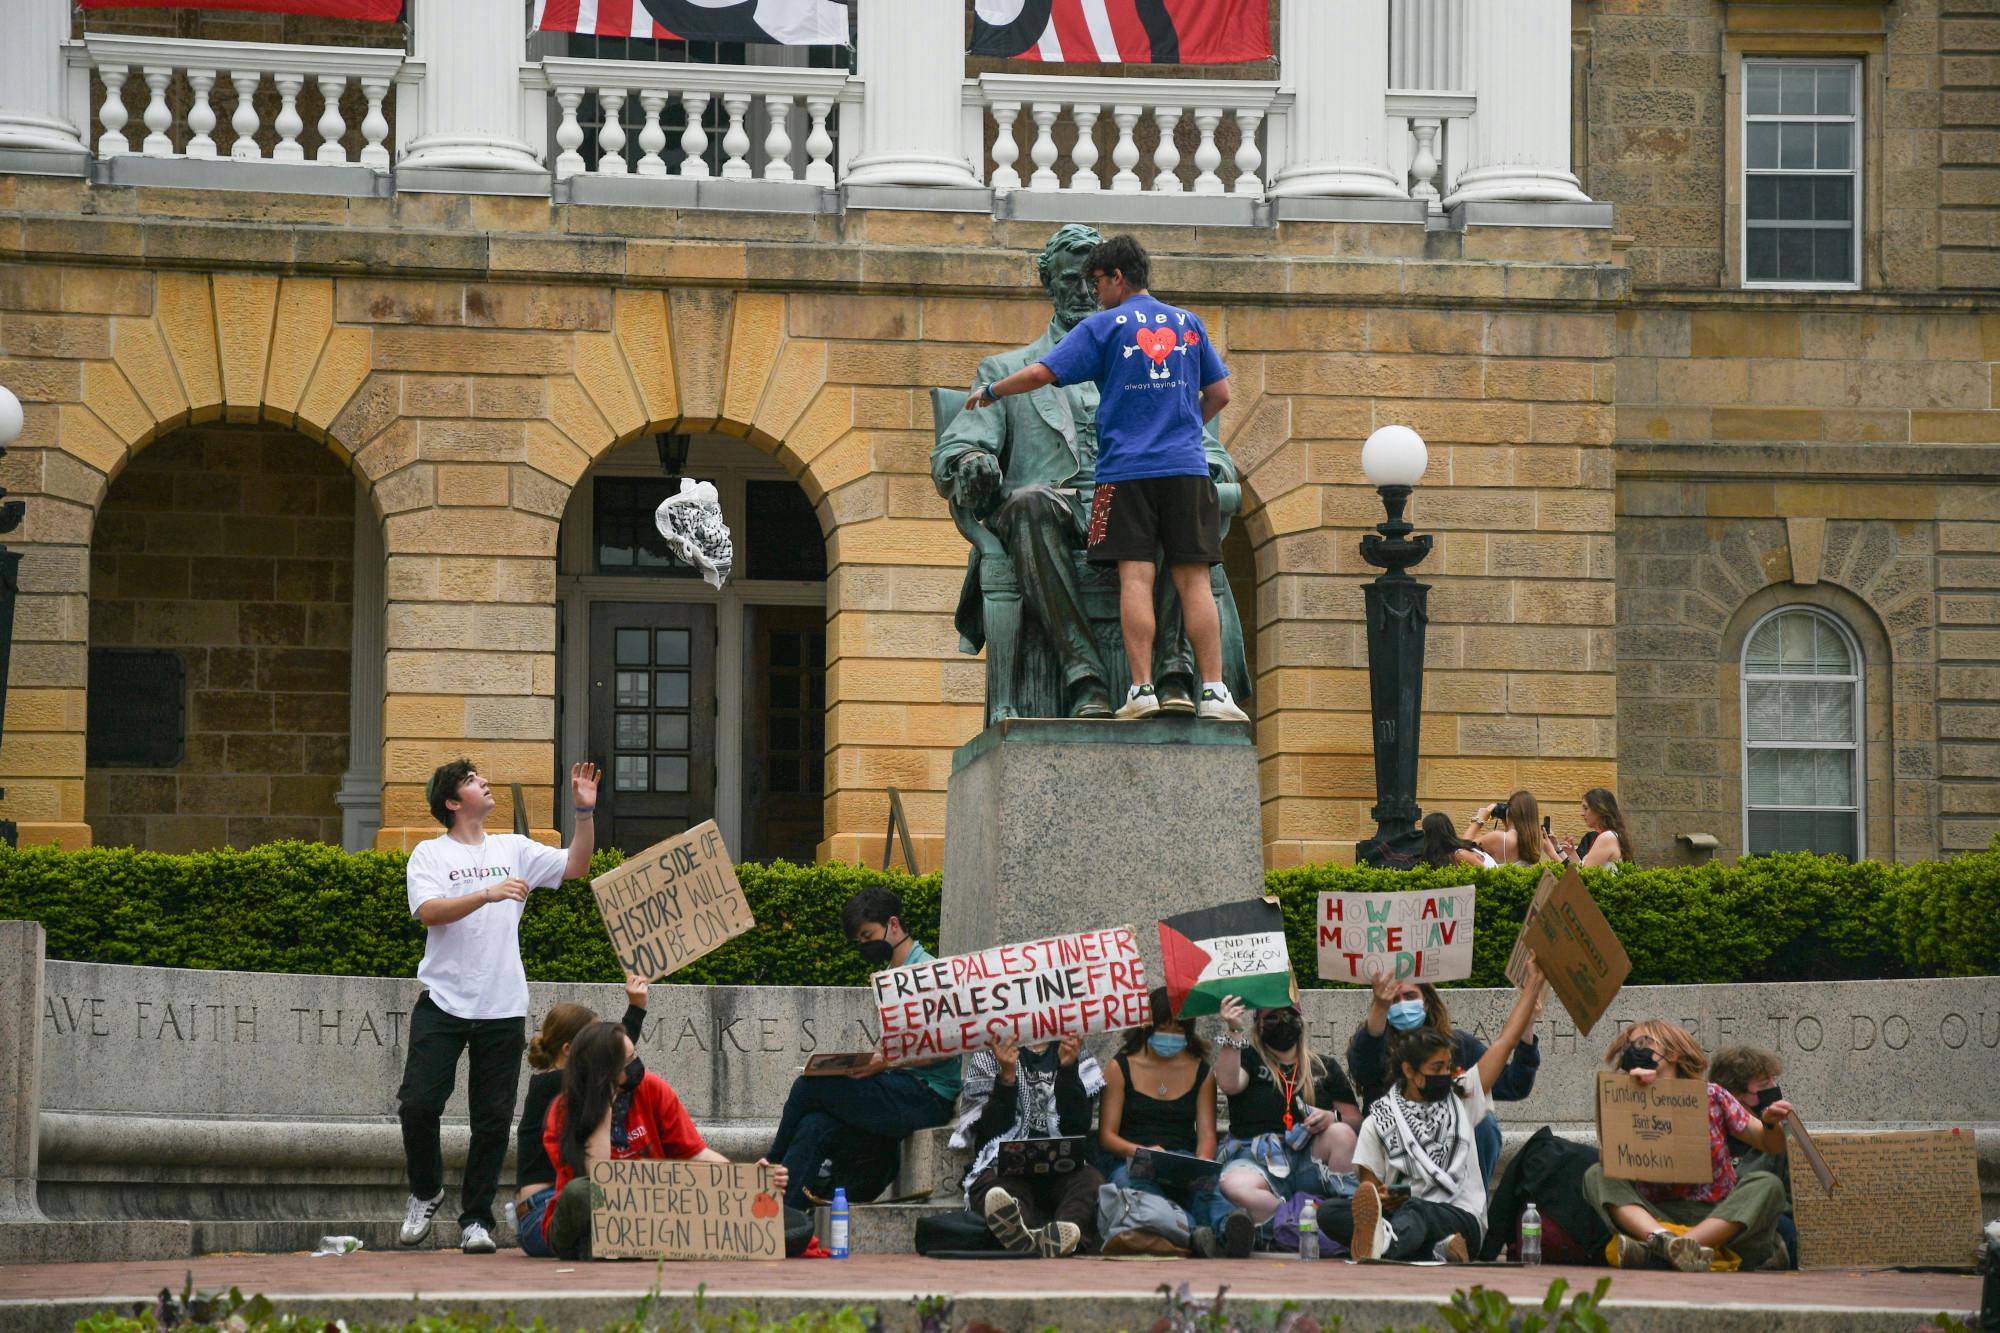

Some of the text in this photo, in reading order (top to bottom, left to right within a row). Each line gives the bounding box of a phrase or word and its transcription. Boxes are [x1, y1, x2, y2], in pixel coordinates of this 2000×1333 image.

[1115, 310, 1186, 326] obey
[596, 830, 719, 915] WHAT SIDE OF
[606, 865, 737, 951] HISTORY WILL
[1326, 893, 1474, 924] HOW MANY
[1214, 935, 1272, 951] END THE
[1319, 918, 1473, 953] MORE HAVE
[619, 937, 668, 979] YOU
[665, 923, 696, 963] BE
[1222, 949, 1281, 962] SIEGE ON
[1343, 949, 1441, 980] TO DIE
[1217, 959, 1268, 977] GAZA
[44, 996, 408, 1050] AVE FAITH THAT
[1767, 1015, 1824, 1052] TO
[1850, 1013, 1912, 1051] DO
[1939, 1011, 2000, 1050] OU
[1604, 1080, 1699, 1110] Funding Genocide
[1651, 1115, 1673, 1134] Sexy
[1618, 1144, 1674, 1169] Mnookin
[593, 1161, 776, 1189] ORANGES DIE IF
[603, 1187, 748, 1217] WATERED BY
[593, 1212, 776, 1256] FOREIGN HANDS
